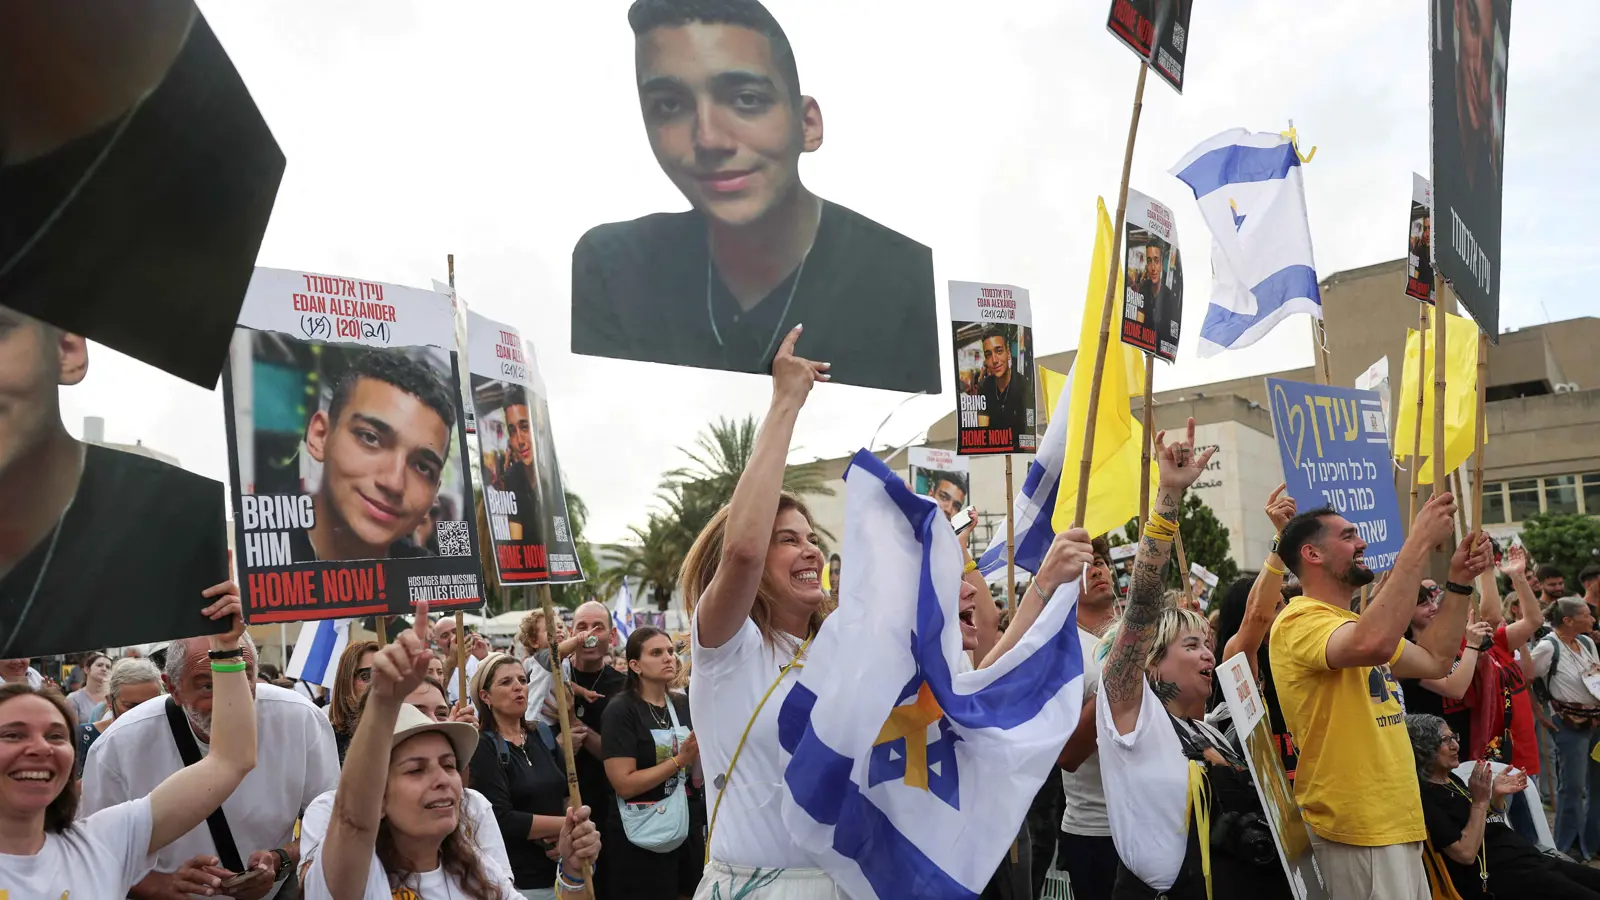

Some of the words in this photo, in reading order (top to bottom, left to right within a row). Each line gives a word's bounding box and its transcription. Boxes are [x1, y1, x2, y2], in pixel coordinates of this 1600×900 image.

[1450, 206, 1477, 279] אלכסנדר
[1477, 246, 1491, 296] עידן
[303, 274, 356, 298] אלכסנדר
[359, 281, 384, 302] עידן
[1126, 286, 1145, 309] BRING
[292, 293, 326, 314] EDAN
[329, 299, 397, 323] ALEXANDER
[977, 298, 990, 308] EDAN
[991, 298, 1016, 309] ALEXANDER
[1125, 302, 1138, 321] HIM
[336, 317, 361, 340] (20)
[1123, 319, 1141, 339] HOME
[495, 343, 512, 360] EDAN
[960, 394, 987, 411] BRING
[961, 410, 978, 428] HIM
[1304, 394, 1359, 458] עידן
[961, 429, 987, 446] HOME
[988, 427, 1013, 446] NOW!
[1301, 457, 1316, 490] לך
[1318, 460, 1349, 482] חיכינו
[1349, 457, 1363, 480] כל
[1363, 457, 1377, 480] כל
[487, 488, 518, 515] BRING
[1349, 487, 1375, 511] כמה
[241, 495, 314, 530] BRING
[491, 515, 511, 541] HIM
[244, 531, 293, 568] HIM
[496, 544, 523, 568] HOME
[248, 570, 318, 609] HOME
[322, 563, 387, 604] NOW!
[407, 576, 438, 587] HOSTAGES
[439, 575, 451, 586] AND
[452, 573, 477, 585] MISSING
[409, 586, 449, 602] FAMILIES
[449, 584, 479, 599] FORUM
